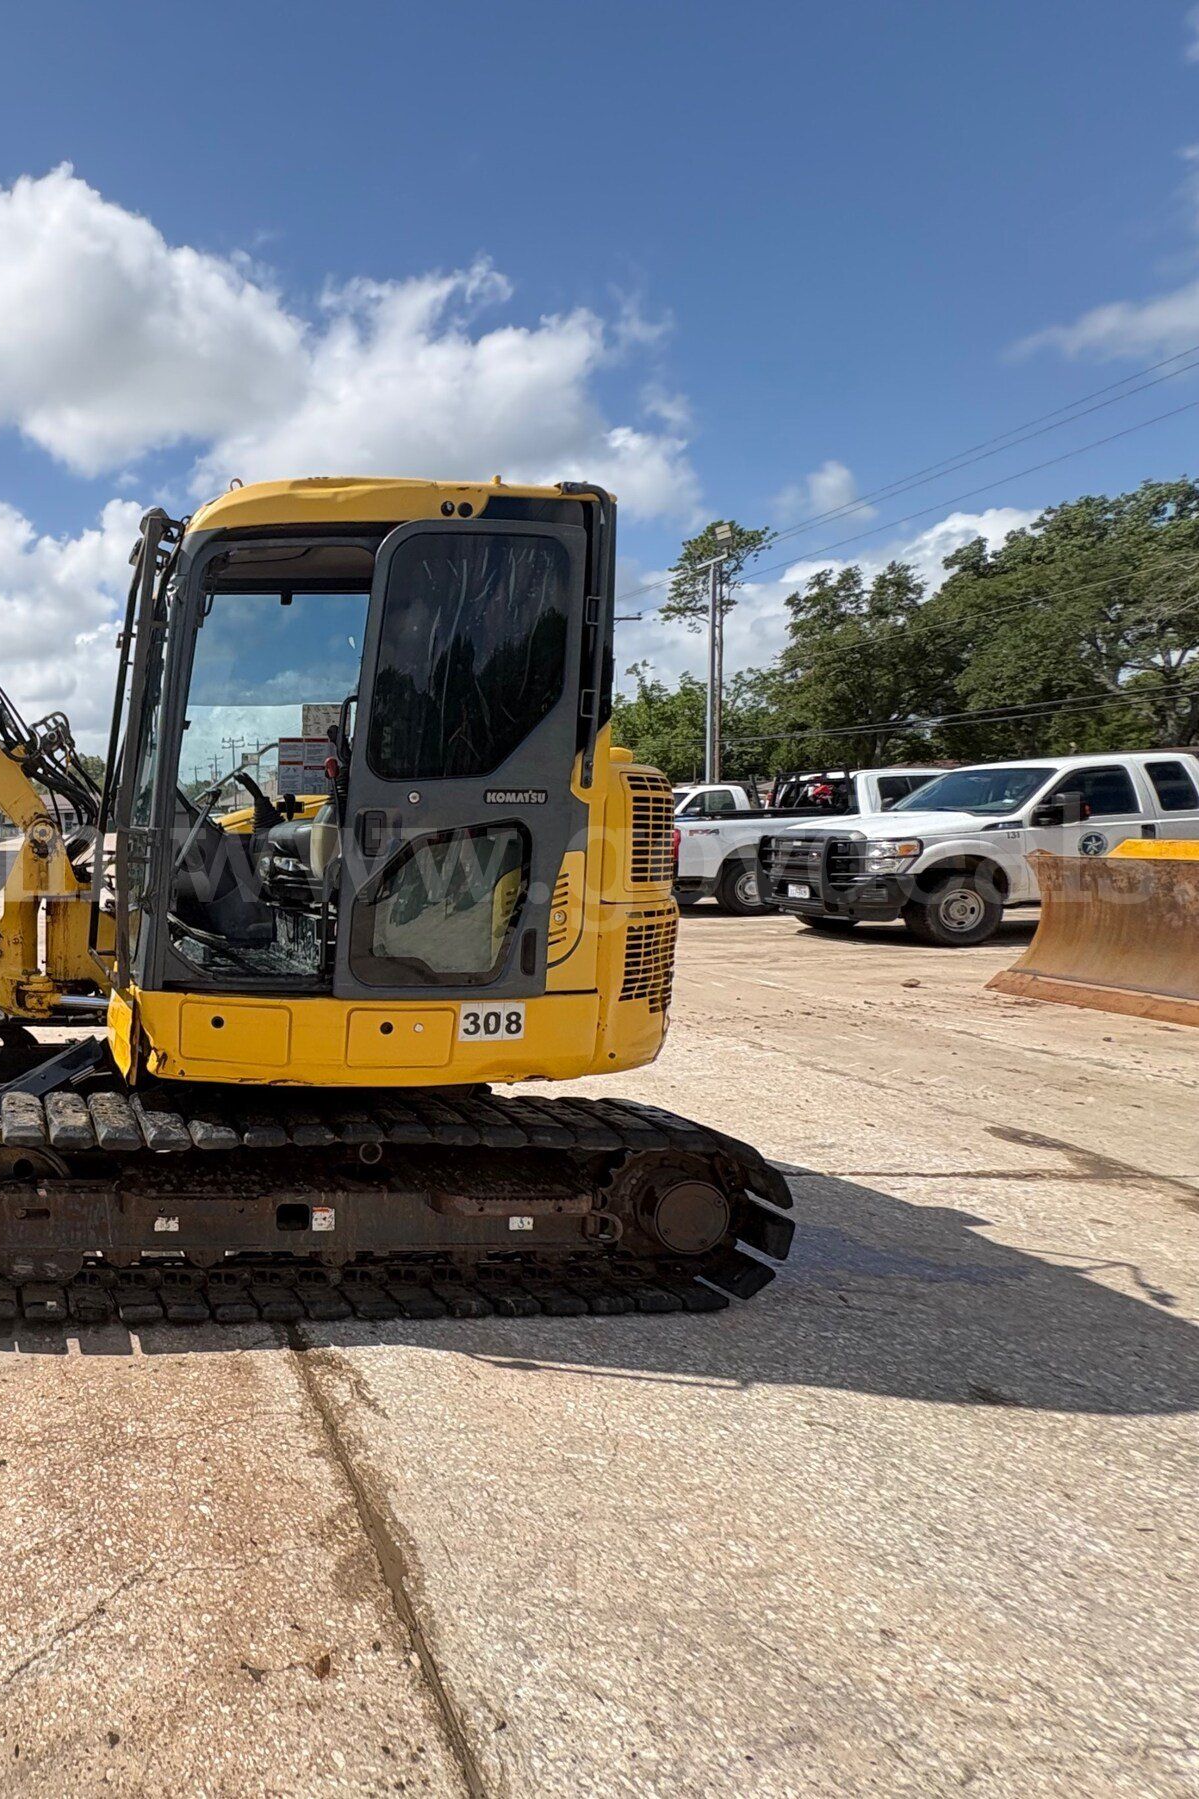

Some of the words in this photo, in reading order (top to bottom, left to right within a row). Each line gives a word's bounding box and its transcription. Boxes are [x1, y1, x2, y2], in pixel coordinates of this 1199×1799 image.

[486, 789, 546, 804] KOMATSU
[689, 829, 720, 837] FX4
[462, 1011, 523, 1036] 308
